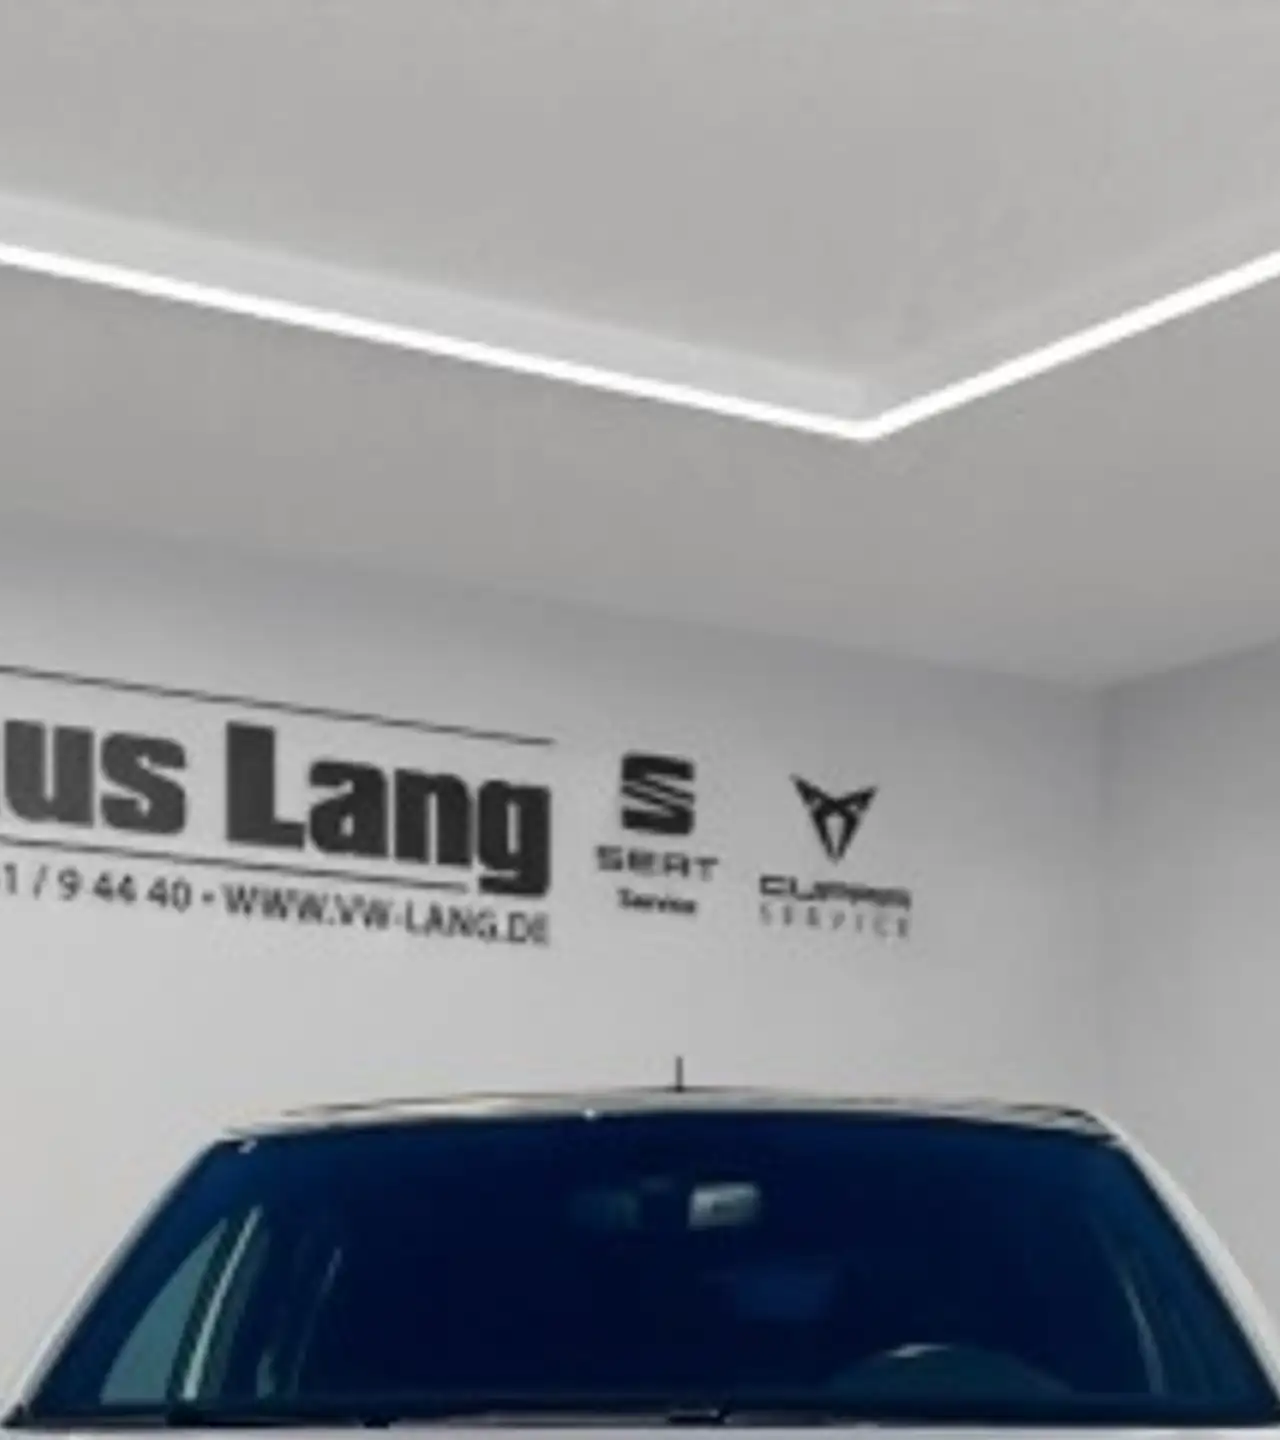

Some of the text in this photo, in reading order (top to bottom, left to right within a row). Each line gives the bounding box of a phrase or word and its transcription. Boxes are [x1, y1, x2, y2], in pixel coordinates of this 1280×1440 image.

[224, 719, 550, 899] Lang
[595, 843, 719, 883] SEAT
[57, 866, 82, 902] 9
[92, 869, 138, 907] 44
[146, 873, 192, 913] 40
